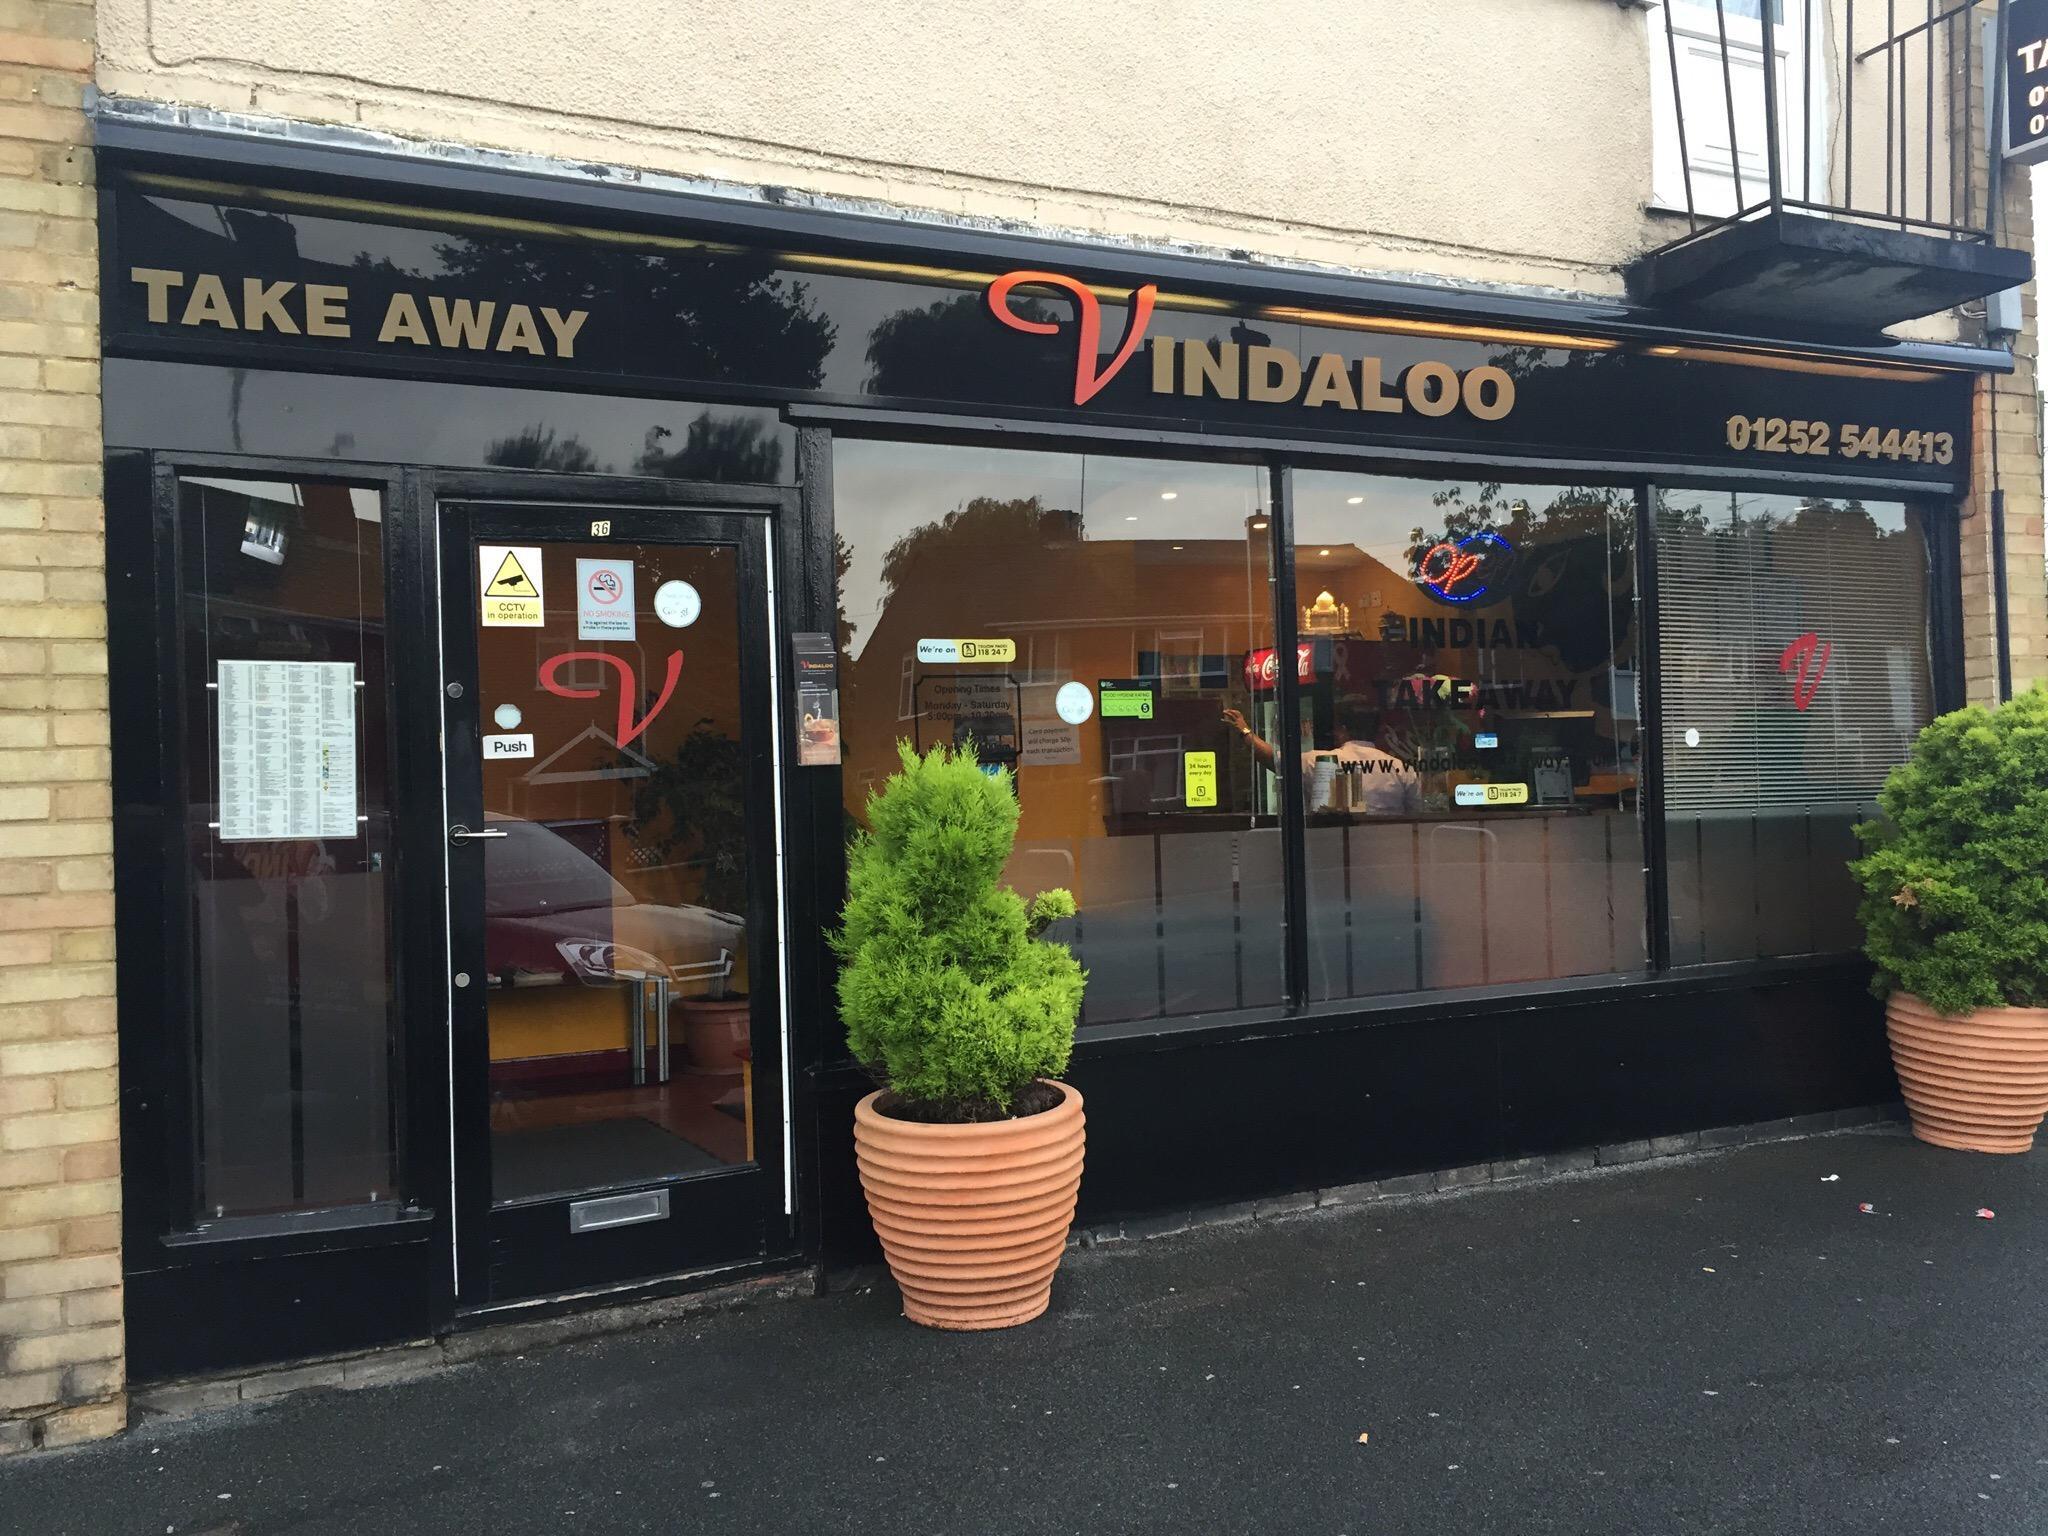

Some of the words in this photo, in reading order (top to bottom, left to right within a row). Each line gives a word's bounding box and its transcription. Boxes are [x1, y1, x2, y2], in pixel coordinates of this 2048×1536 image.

[2029, 86, 2048, 107] 0
[2030, 114, 2048, 134] 0
[131, 267, 351, 338] TAKE
[377, 292, 589, 359] AWAY
[987, 270, 1516, 421] VINDALOO
[1726, 414, 1831, 456] 01252
[1839, 424, 1954, 466] 544413
[593, 522, 609, 536] 36
[499, 602, 526, 612] CCTV
[497, 612, 538, 620] operation
[919, 645, 944, 654] We're
[977, 648, 990, 656] 118
[991, 648, 1001, 656] 24
[934, 684, 972, 695] Opening
[973, 684, 1000, 693] Times
[539, 649, 685, 750] V
[925, 701, 962, 711] Monday
[970, 700, 1011, 711] Saturday
[1142, 704, 1148, 712] 5
[494, 741, 527, 753] Push
